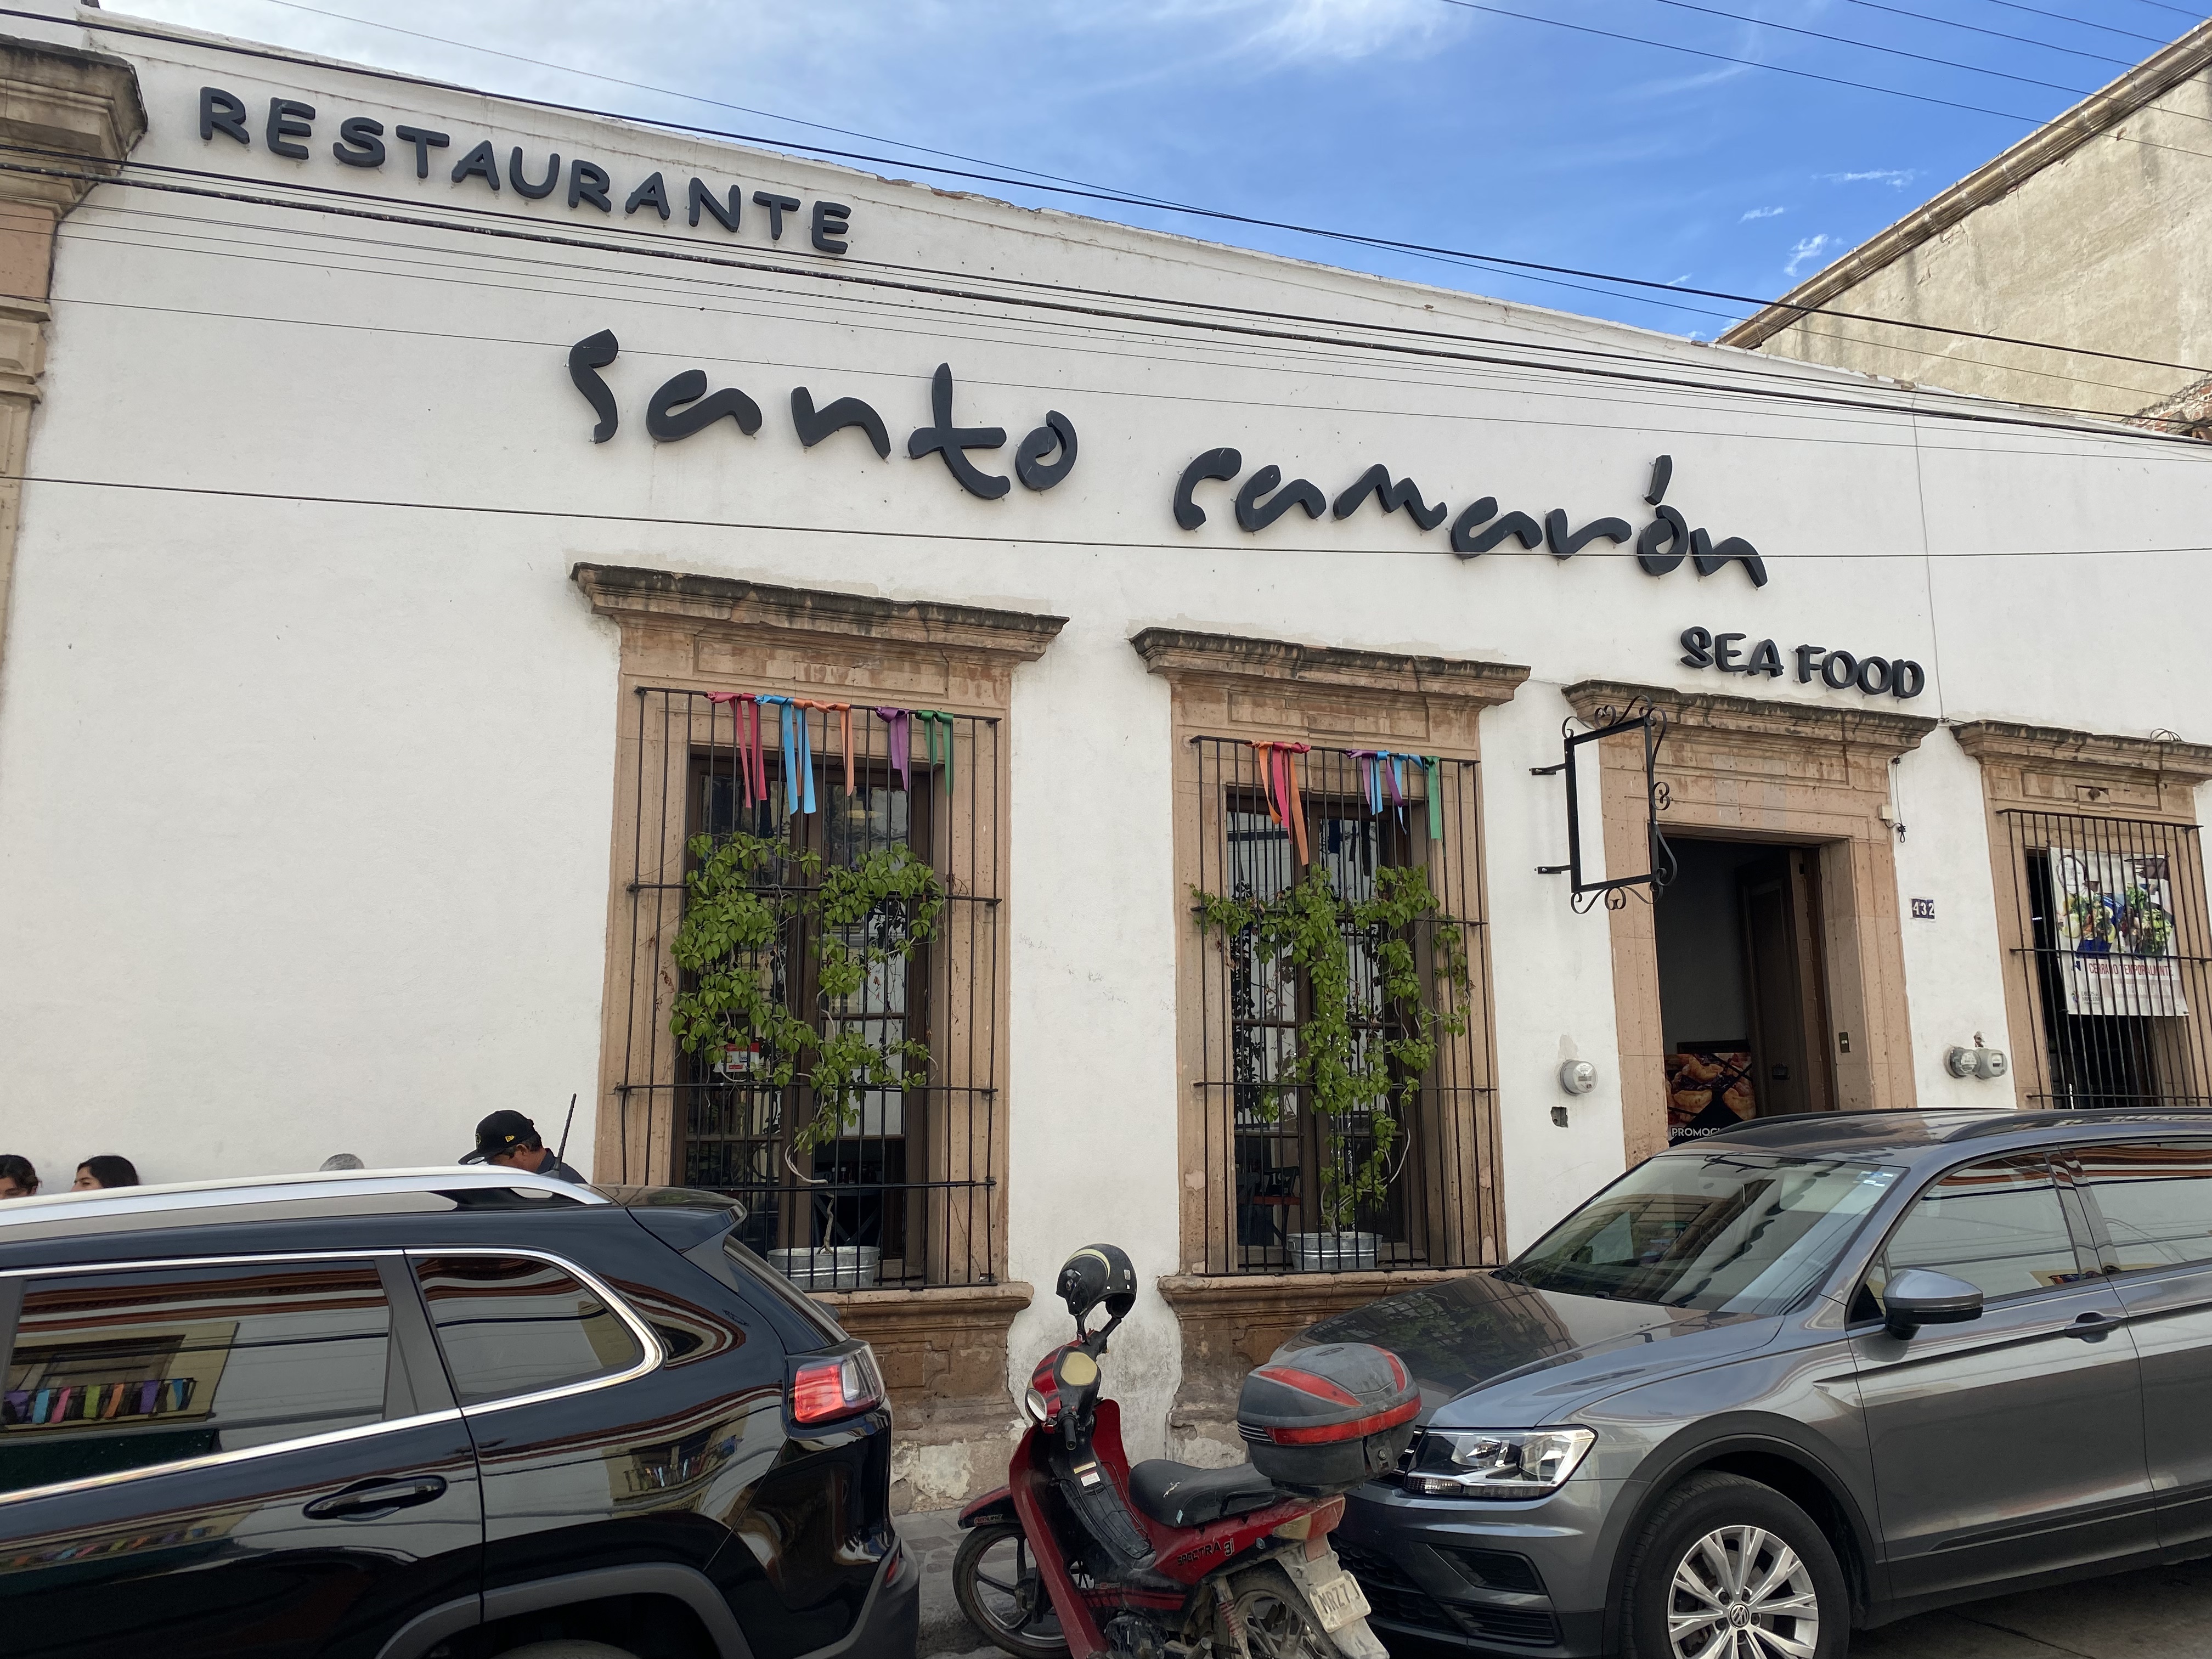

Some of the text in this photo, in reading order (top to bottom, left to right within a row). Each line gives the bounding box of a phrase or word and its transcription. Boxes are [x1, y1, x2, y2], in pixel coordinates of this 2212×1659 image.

[199, 86, 853, 256] RESTAURANTE
[1680, 625, 1925, 699] SEA FOOD
[1912, 901, 1934, 916] 432
[1177, 1541, 1222, 1566] SPECTRA
